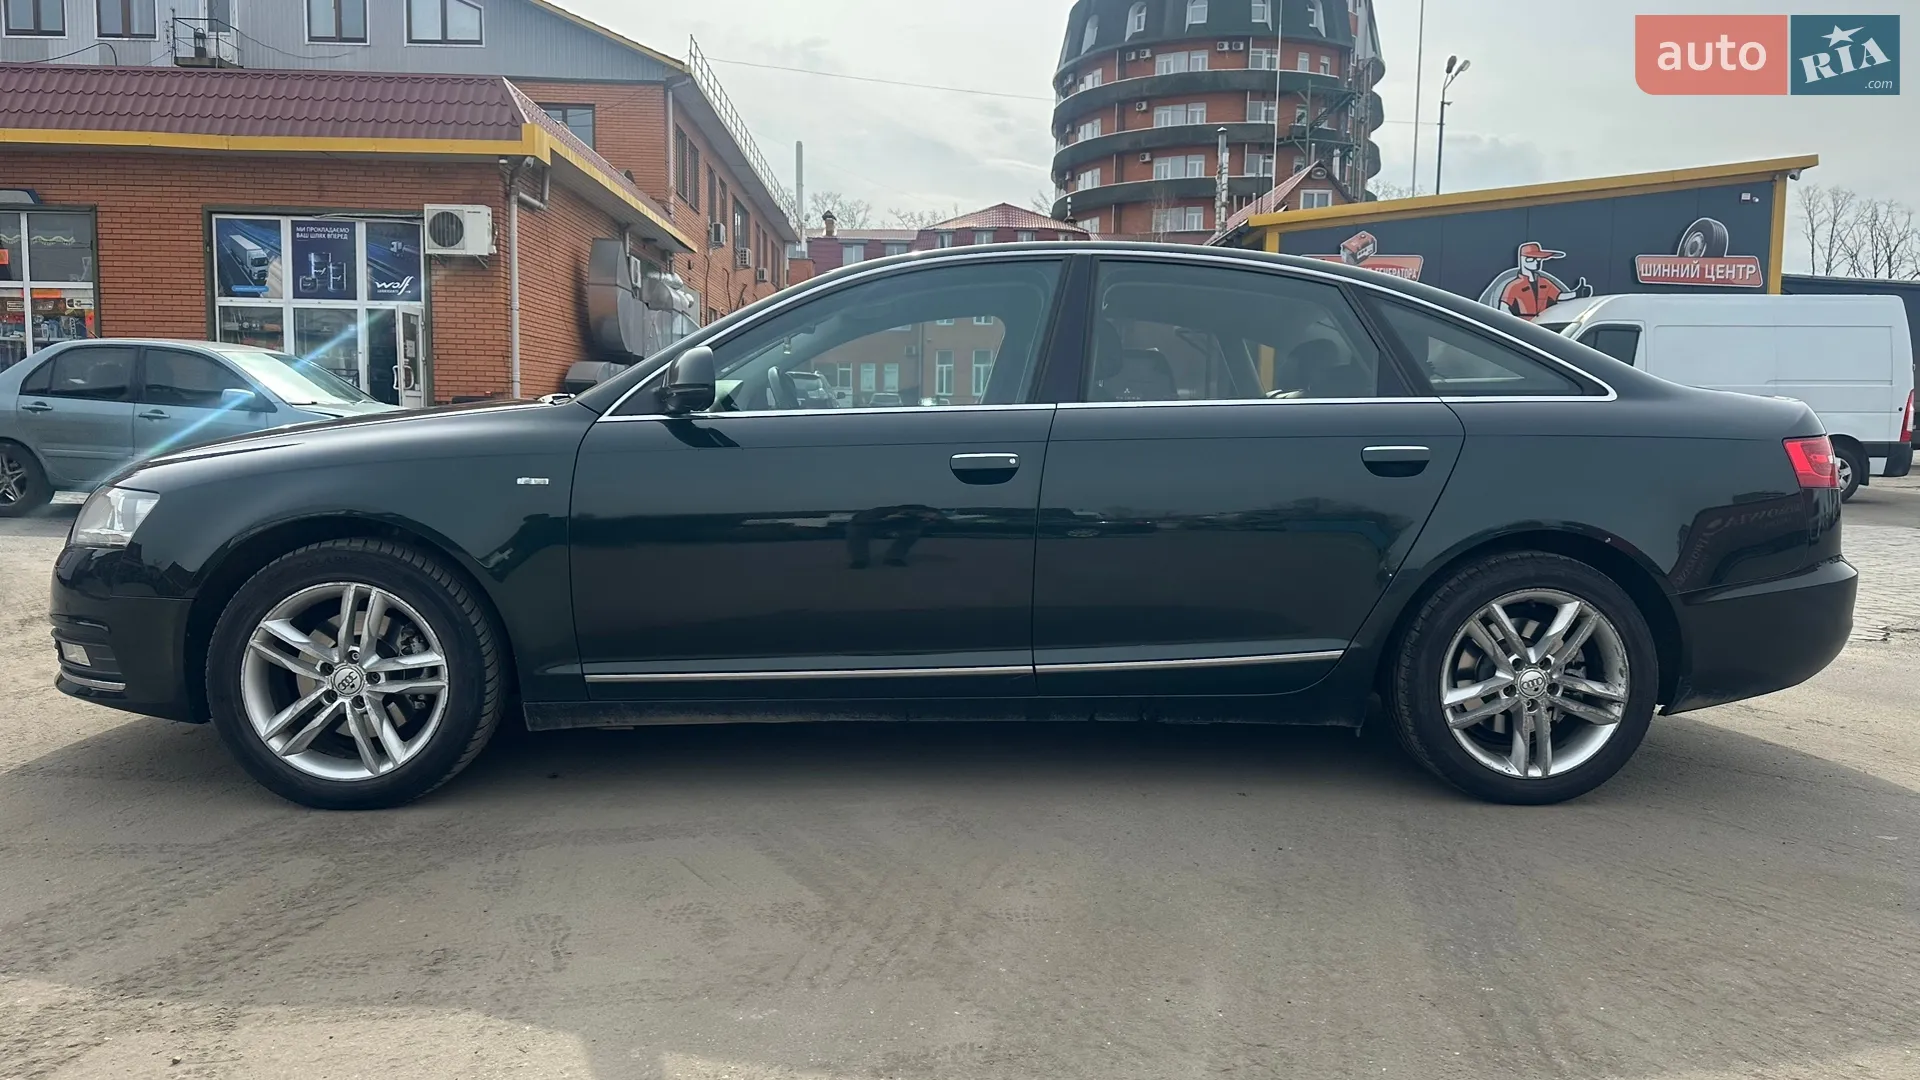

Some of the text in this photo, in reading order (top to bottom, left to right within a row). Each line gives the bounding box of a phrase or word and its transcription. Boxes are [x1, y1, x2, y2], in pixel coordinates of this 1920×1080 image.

[1641, 260, 1757, 282] ШИННИЙ ЦЕНТР
[374, 275, 415, 296] wolf
